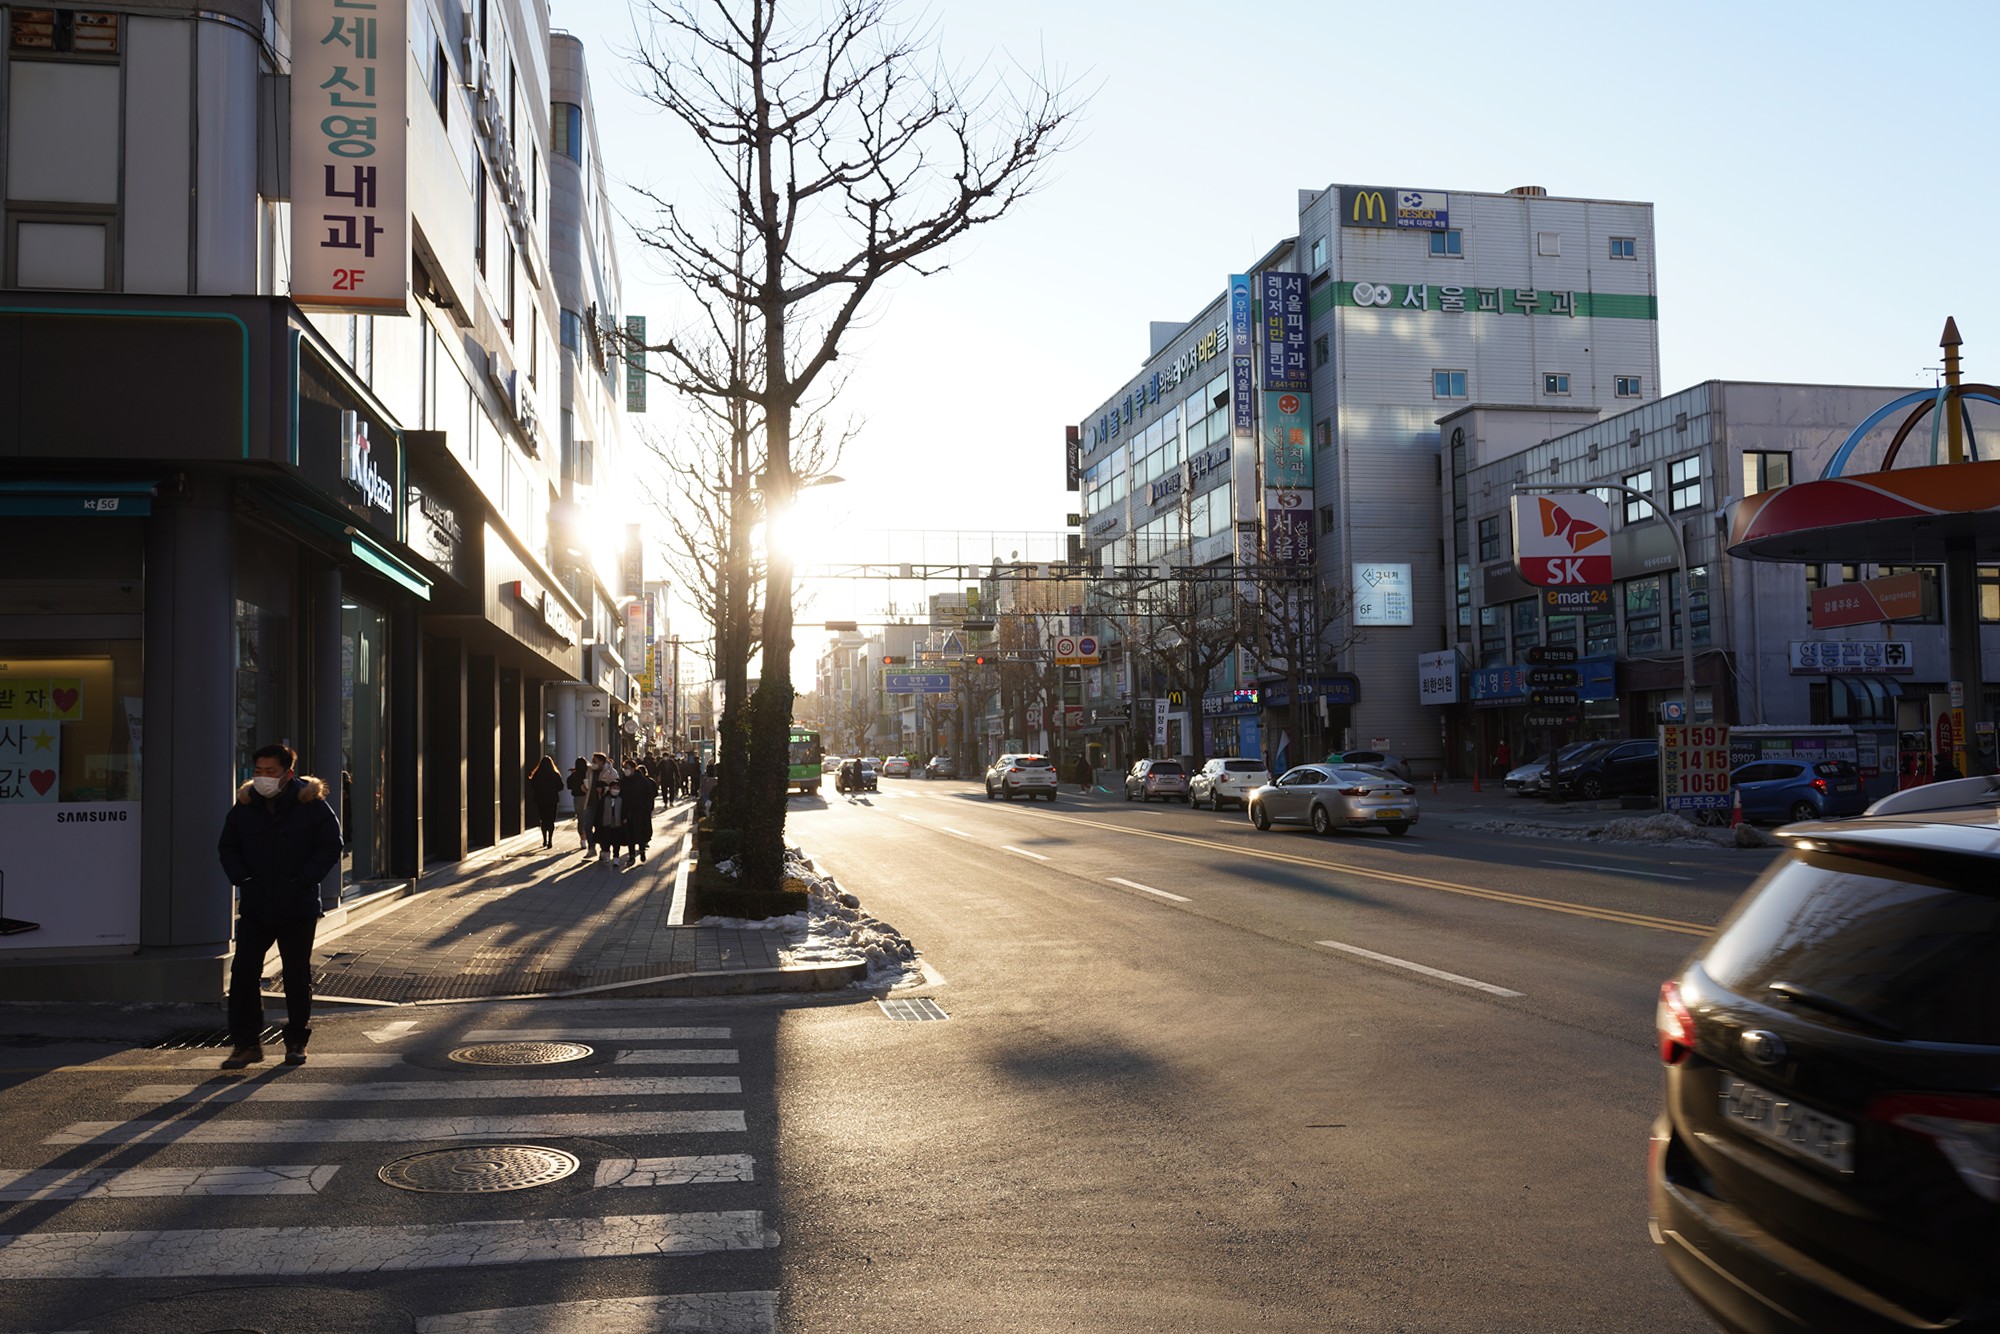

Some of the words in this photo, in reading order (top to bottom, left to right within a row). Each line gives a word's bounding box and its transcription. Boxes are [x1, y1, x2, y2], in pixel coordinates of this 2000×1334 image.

[1398, 209, 1436, 220] DESIGN
[332, 269, 366, 290] 2F
[1401, 282, 1578, 319] 서울피부과
[1236, 300, 1247, 346] 우리은행
[1286, 277, 1306, 369] 서울피부과
[1099, 371, 1160, 444] 서울피부과
[1237, 368, 1250, 428] 서울피부과
[84, 499, 96, 509] kt
[101, 500, 115, 509] 5G
[1273, 513, 1292, 560] 서울
[1547, 558, 1587, 584] SK
[1547, 590, 1608, 605] emart24
[1824, 597, 1860, 613] 강릉주유소
[1880, 590, 1917, 602] Gangneung
[1360, 604, 1373, 614] 6F
[1061, 643, 1071, 651] 50
[1423, 676, 1452, 694] 최한의원
[1477, 670, 1525, 694] 신영유리
[1680, 727, 1728, 746] 1597
[1939, 722, 1950, 753] SELF
[1680, 750, 1728, 769] 1415
[1680, 773, 1728, 792] 1050
[1668, 795, 1729, 810] 셀프주유소
[57, 811, 128, 822] SAMSUNG
